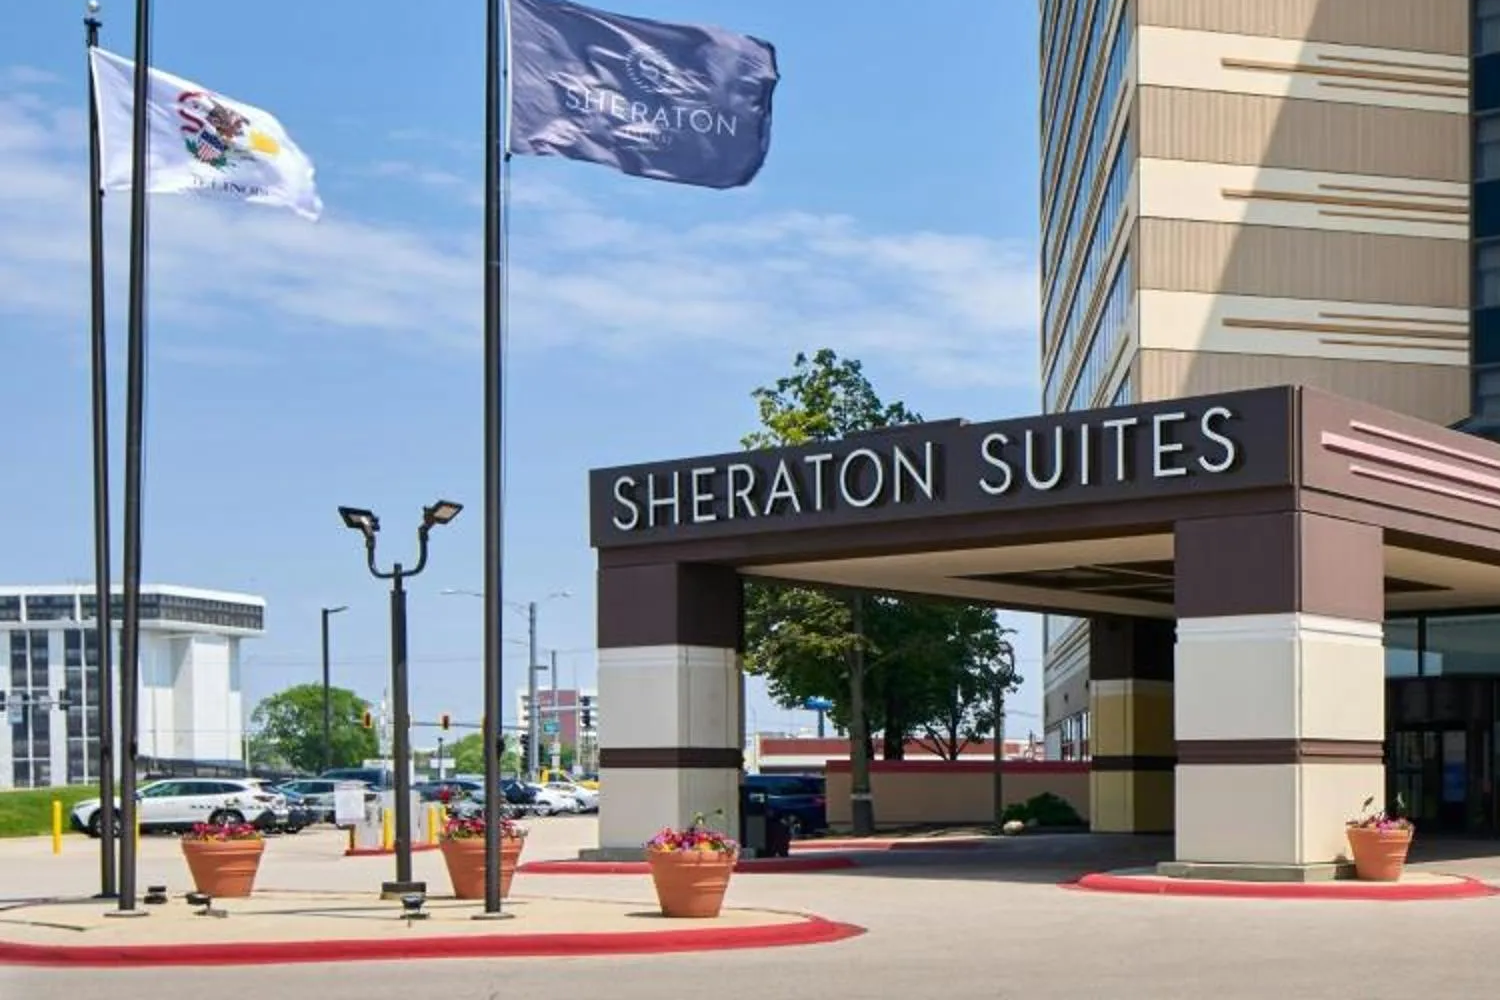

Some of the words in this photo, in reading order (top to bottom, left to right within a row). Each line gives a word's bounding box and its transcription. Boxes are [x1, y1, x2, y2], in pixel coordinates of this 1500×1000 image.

[565, 86, 738, 137] SHERATON
[612, 441, 934, 531] SHERATON
[978, 406, 1236, 495] SUITES
